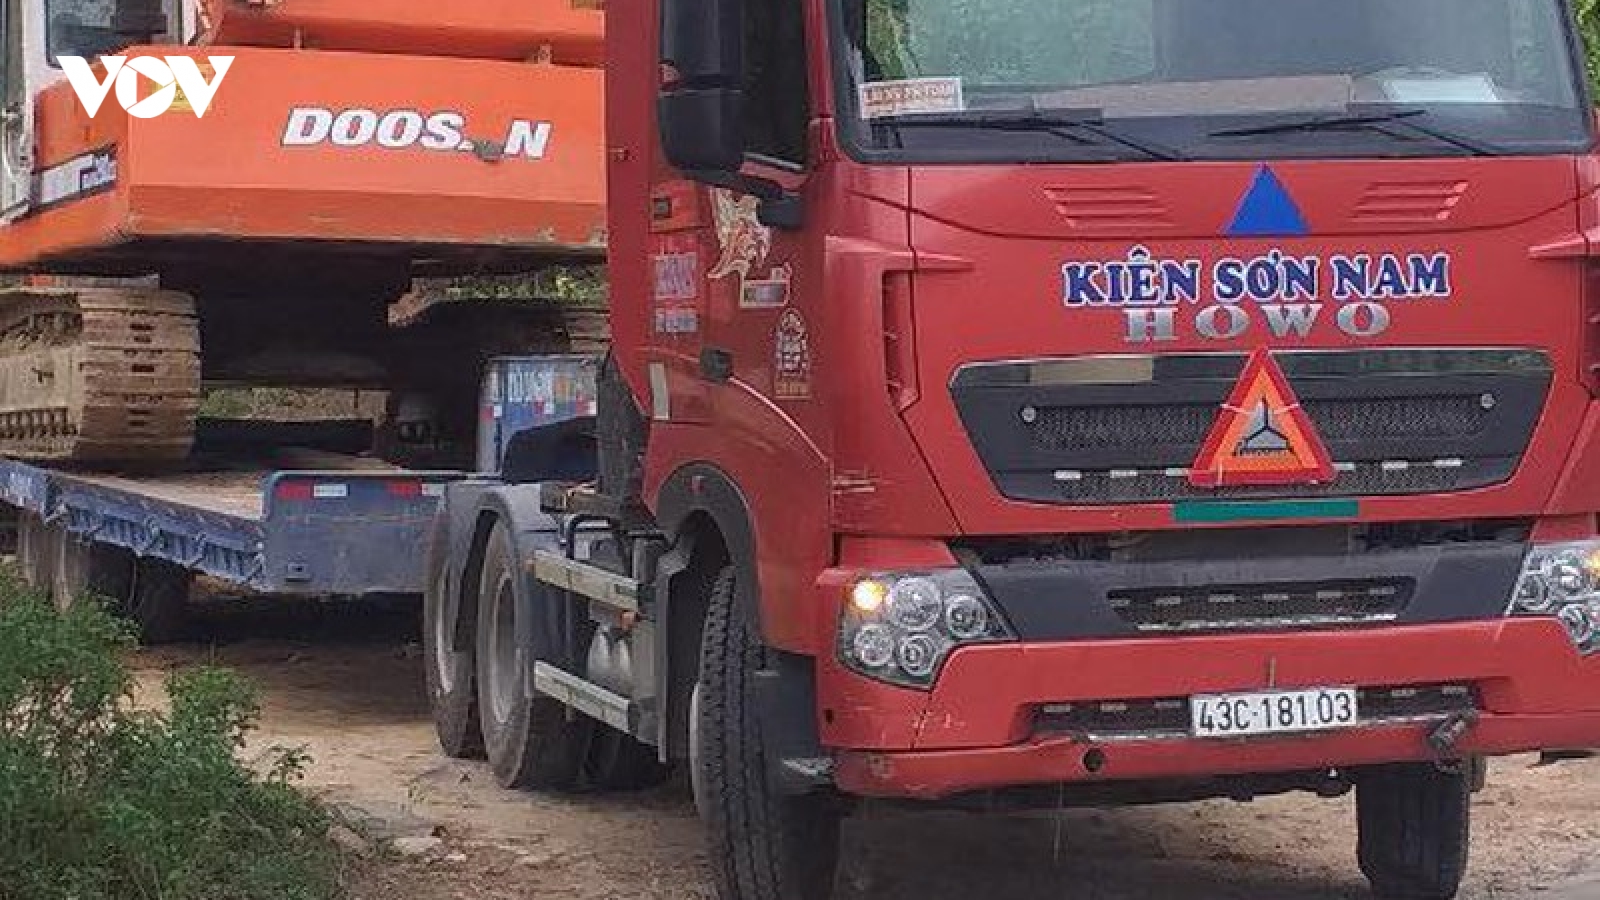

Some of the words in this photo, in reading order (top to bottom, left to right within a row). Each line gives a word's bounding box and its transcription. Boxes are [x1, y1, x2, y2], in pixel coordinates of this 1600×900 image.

[282, 107, 552, 160] DOOSN
[1062, 246, 1200, 306] KIÊN
[1213, 250, 1319, 301] SƠN
[1332, 253, 1452, 299] NAM
[1124, 303, 1393, 342] HOWO
[1198, 692, 1352, 732] 43C-181.03
